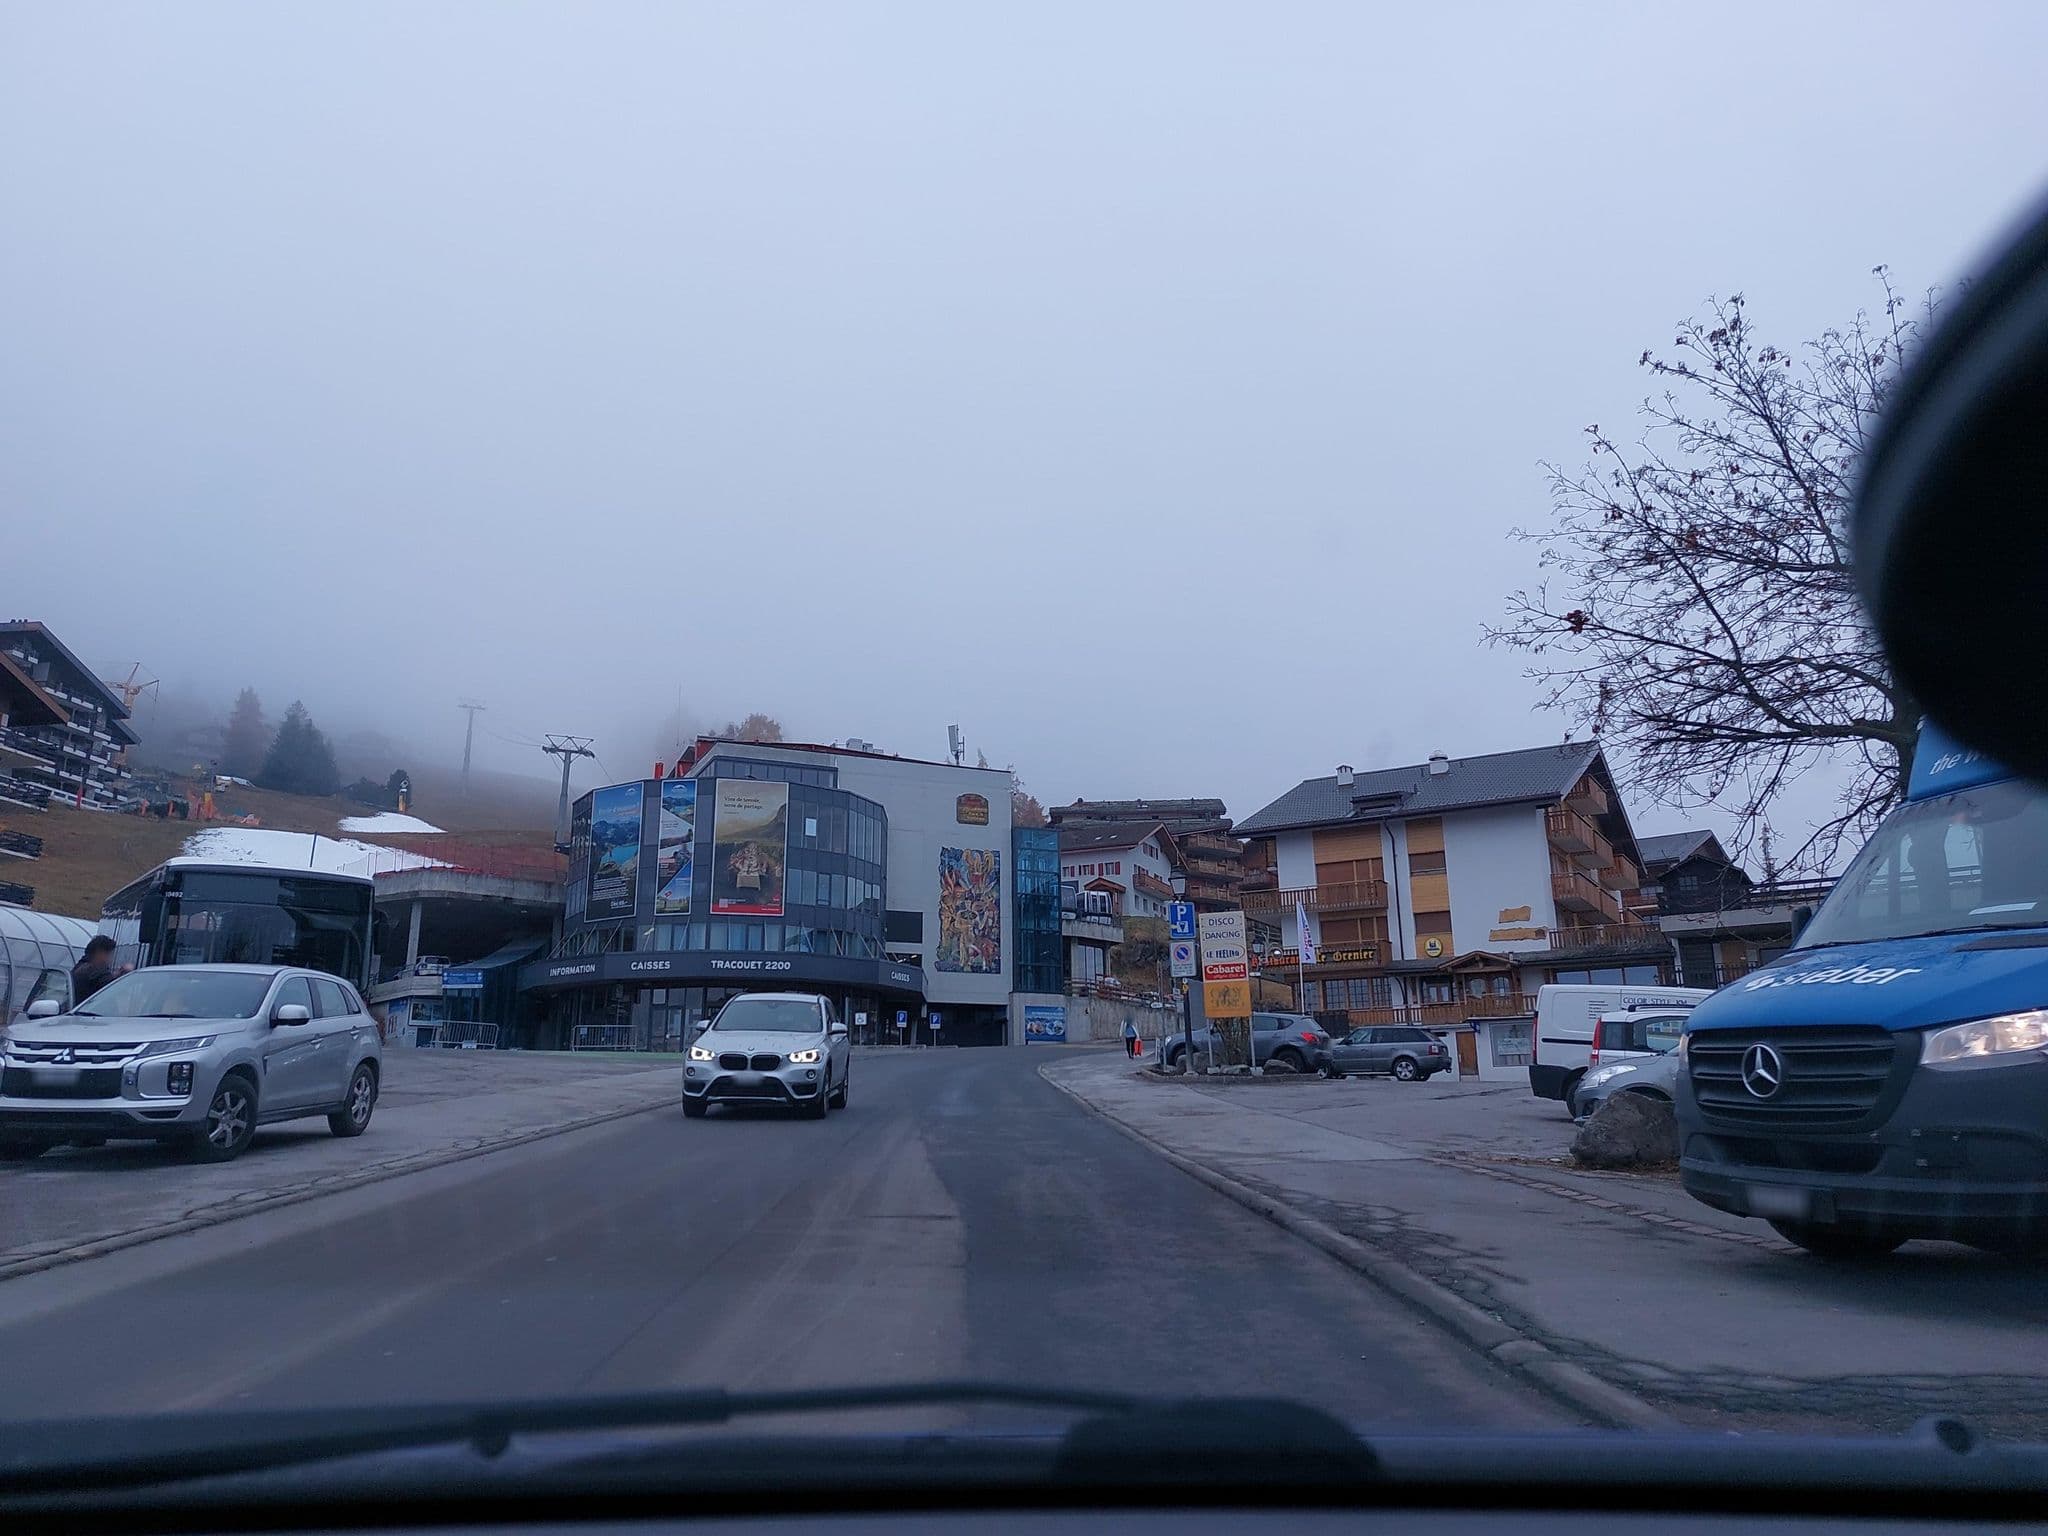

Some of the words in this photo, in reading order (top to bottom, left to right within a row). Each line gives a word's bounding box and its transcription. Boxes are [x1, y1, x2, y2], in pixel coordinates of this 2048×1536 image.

[1929, 752, 1962, 776] the
[1208, 918, 1235, 926] DISCO
[1205, 931, 1241, 940] DANCING
[1333, 950, 1374, 961] Grenier
[549, 964, 596, 977] INFORMATION
[630, 961, 671, 971] CAISSES
[710, 960, 763, 970] TRACOUET
[764, 961, 791, 970] 2200
[1206, 964, 1245, 975] Cabaret
[890, 970, 911, 983] CAISSES
